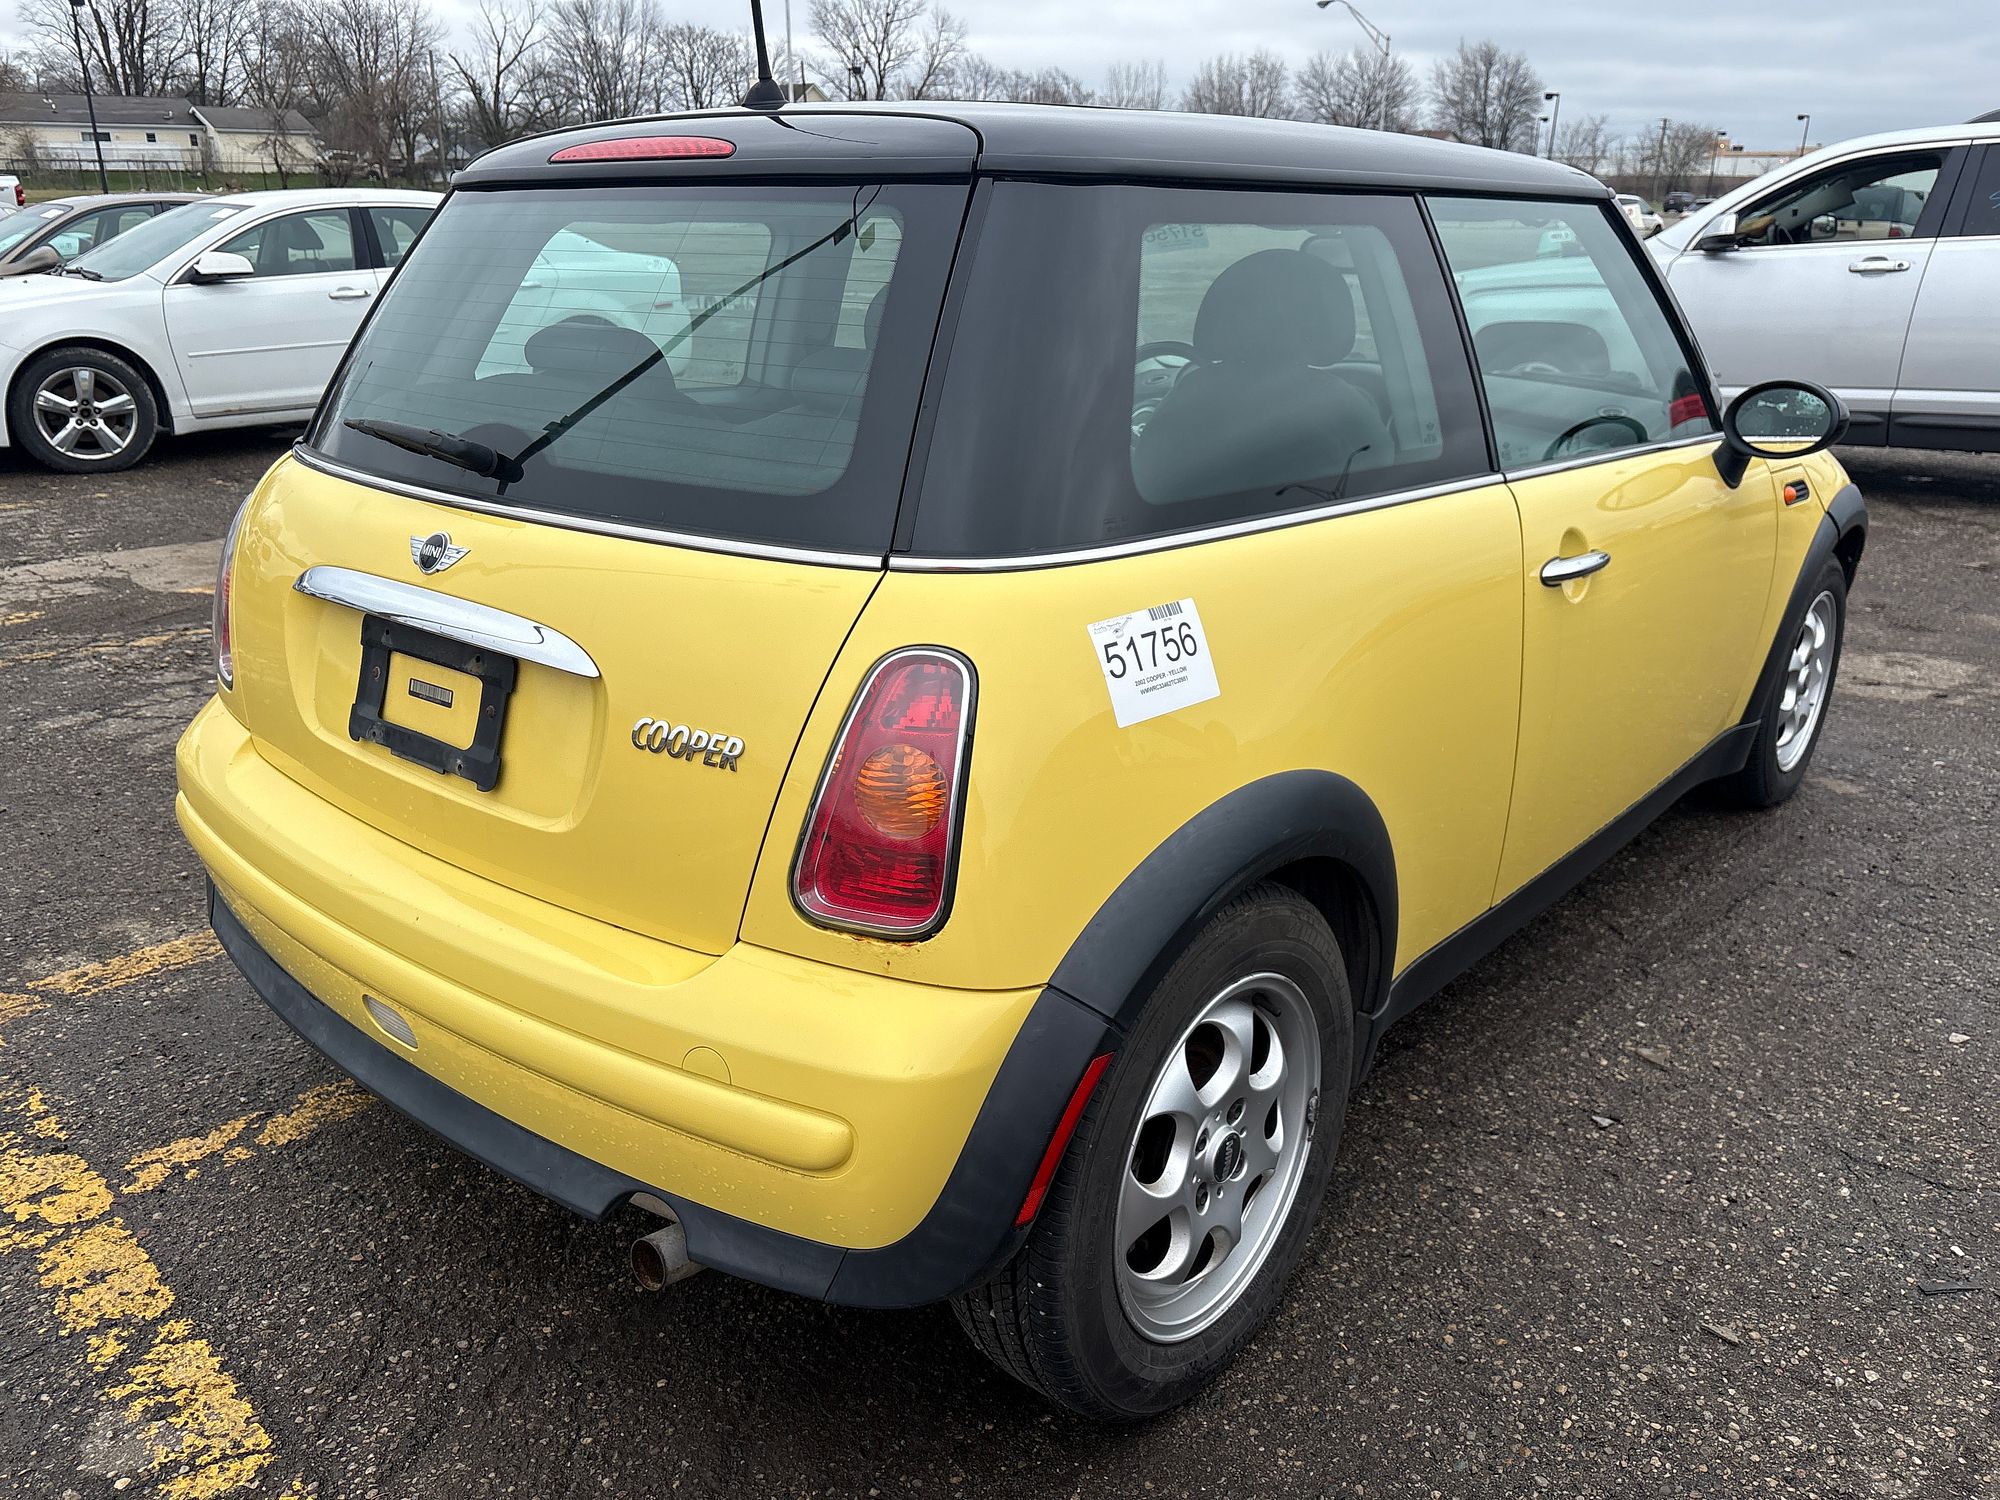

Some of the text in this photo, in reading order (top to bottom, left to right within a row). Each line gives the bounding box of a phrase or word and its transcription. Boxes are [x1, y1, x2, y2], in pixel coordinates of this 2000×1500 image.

[421, 544, 441, 558] MINI
[1104, 622, 1197, 679] 51756
[1146, 672, 1167, 683] COOPER
[1168, 666, 1187, 676] YELLOW
[631, 717, 746, 772] COOPER
